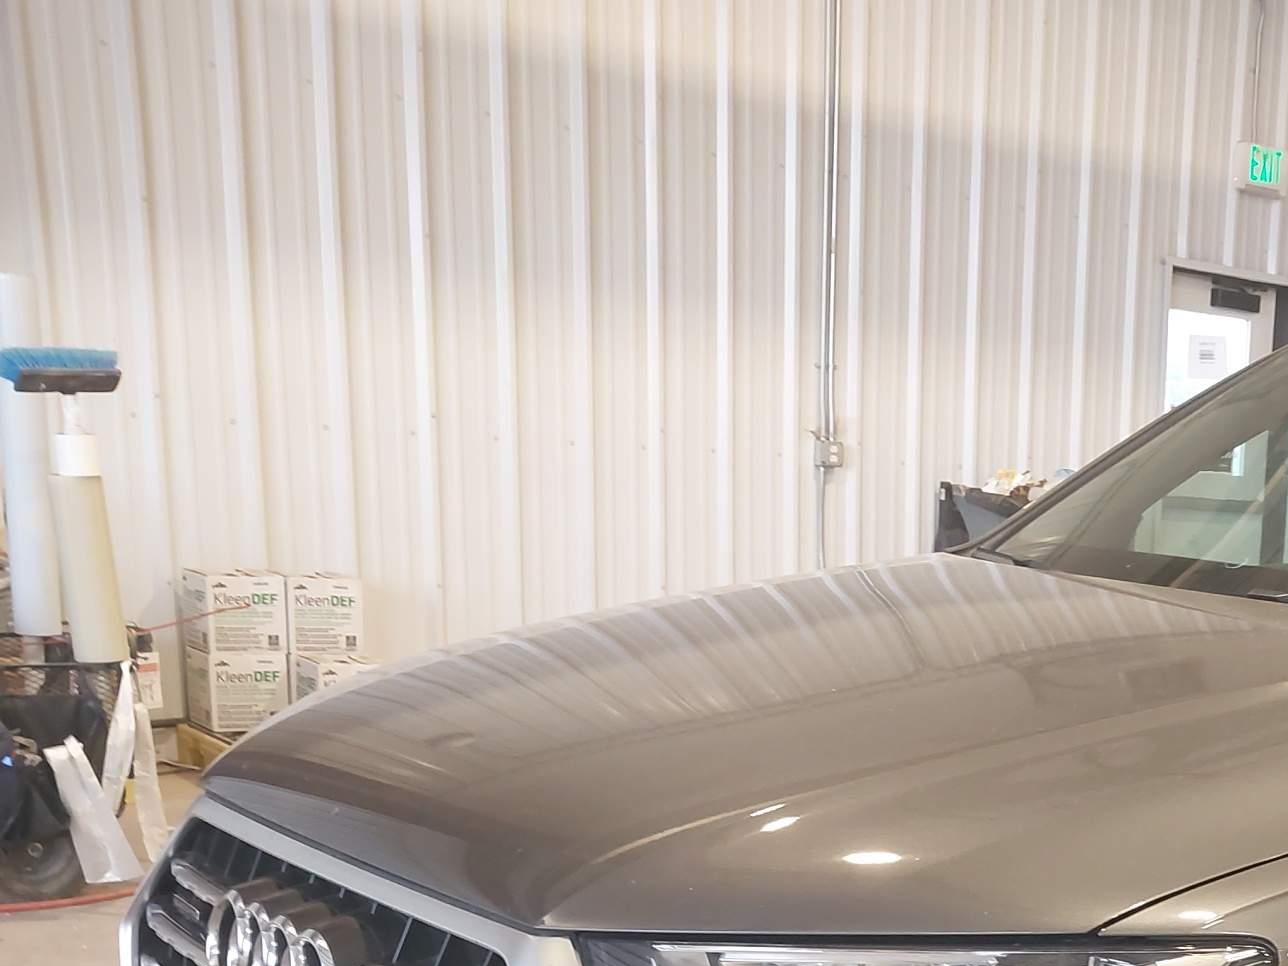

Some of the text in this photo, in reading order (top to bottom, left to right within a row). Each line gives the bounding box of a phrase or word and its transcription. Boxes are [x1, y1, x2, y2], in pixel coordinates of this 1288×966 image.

[1250, 145, 1282, 184] EXIT
[213, 592, 279, 606] KleenDEF
[295, 594, 356, 608] KleenDEF
[215, 670, 280, 684] KleenDEF
